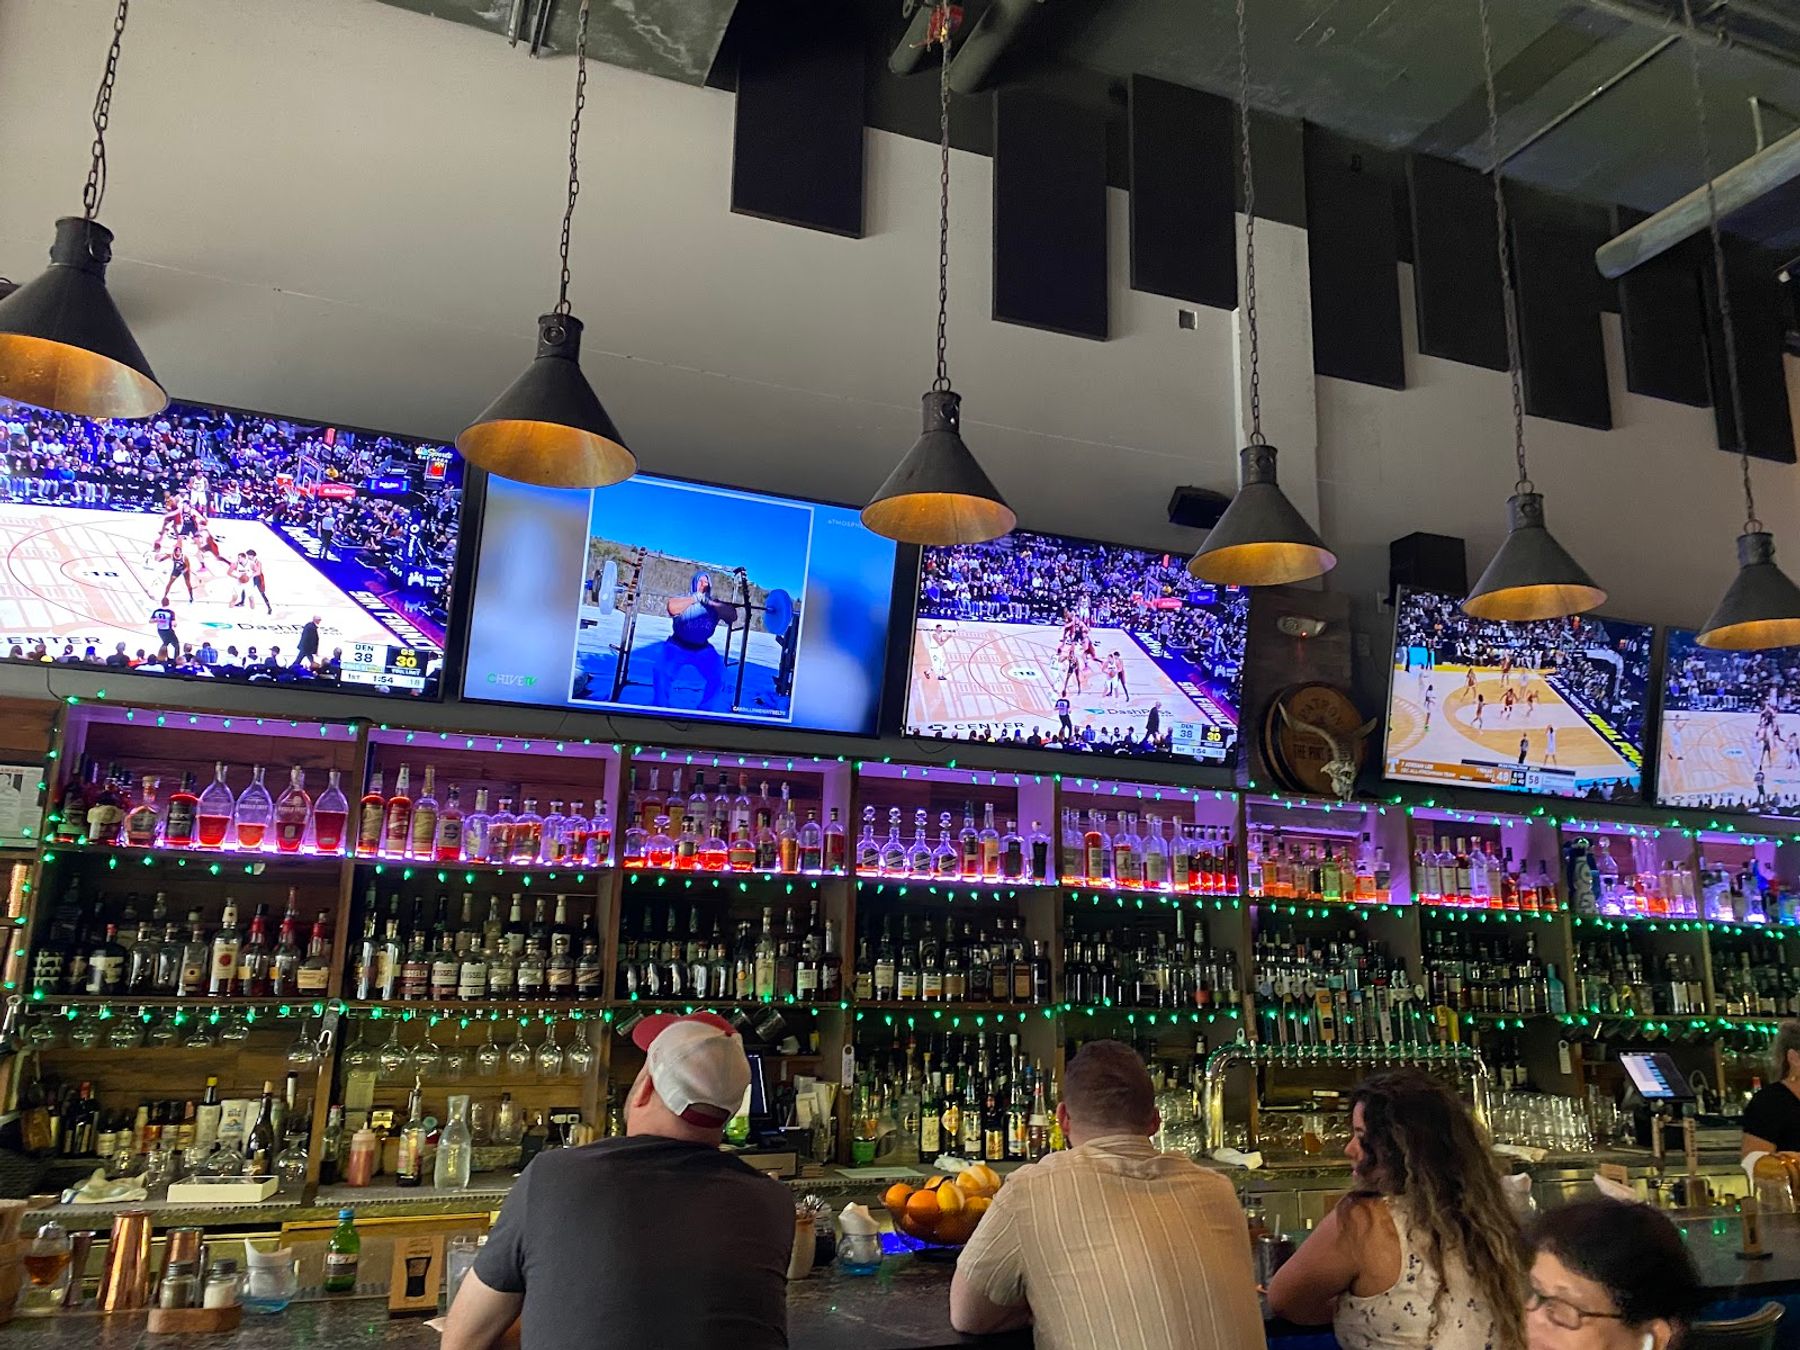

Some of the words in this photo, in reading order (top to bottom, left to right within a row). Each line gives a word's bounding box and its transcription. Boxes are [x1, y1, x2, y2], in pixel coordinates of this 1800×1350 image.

[355, 644, 374, 652] DEN
[354, 653, 373, 663] 38
[396, 656, 417, 668] 30
[373, 675, 394, 684] 1:54
[955, 723, 1024, 731] CENTER
[1180, 730, 1193, 738] 38
[1207, 732, 1221, 741] 30
